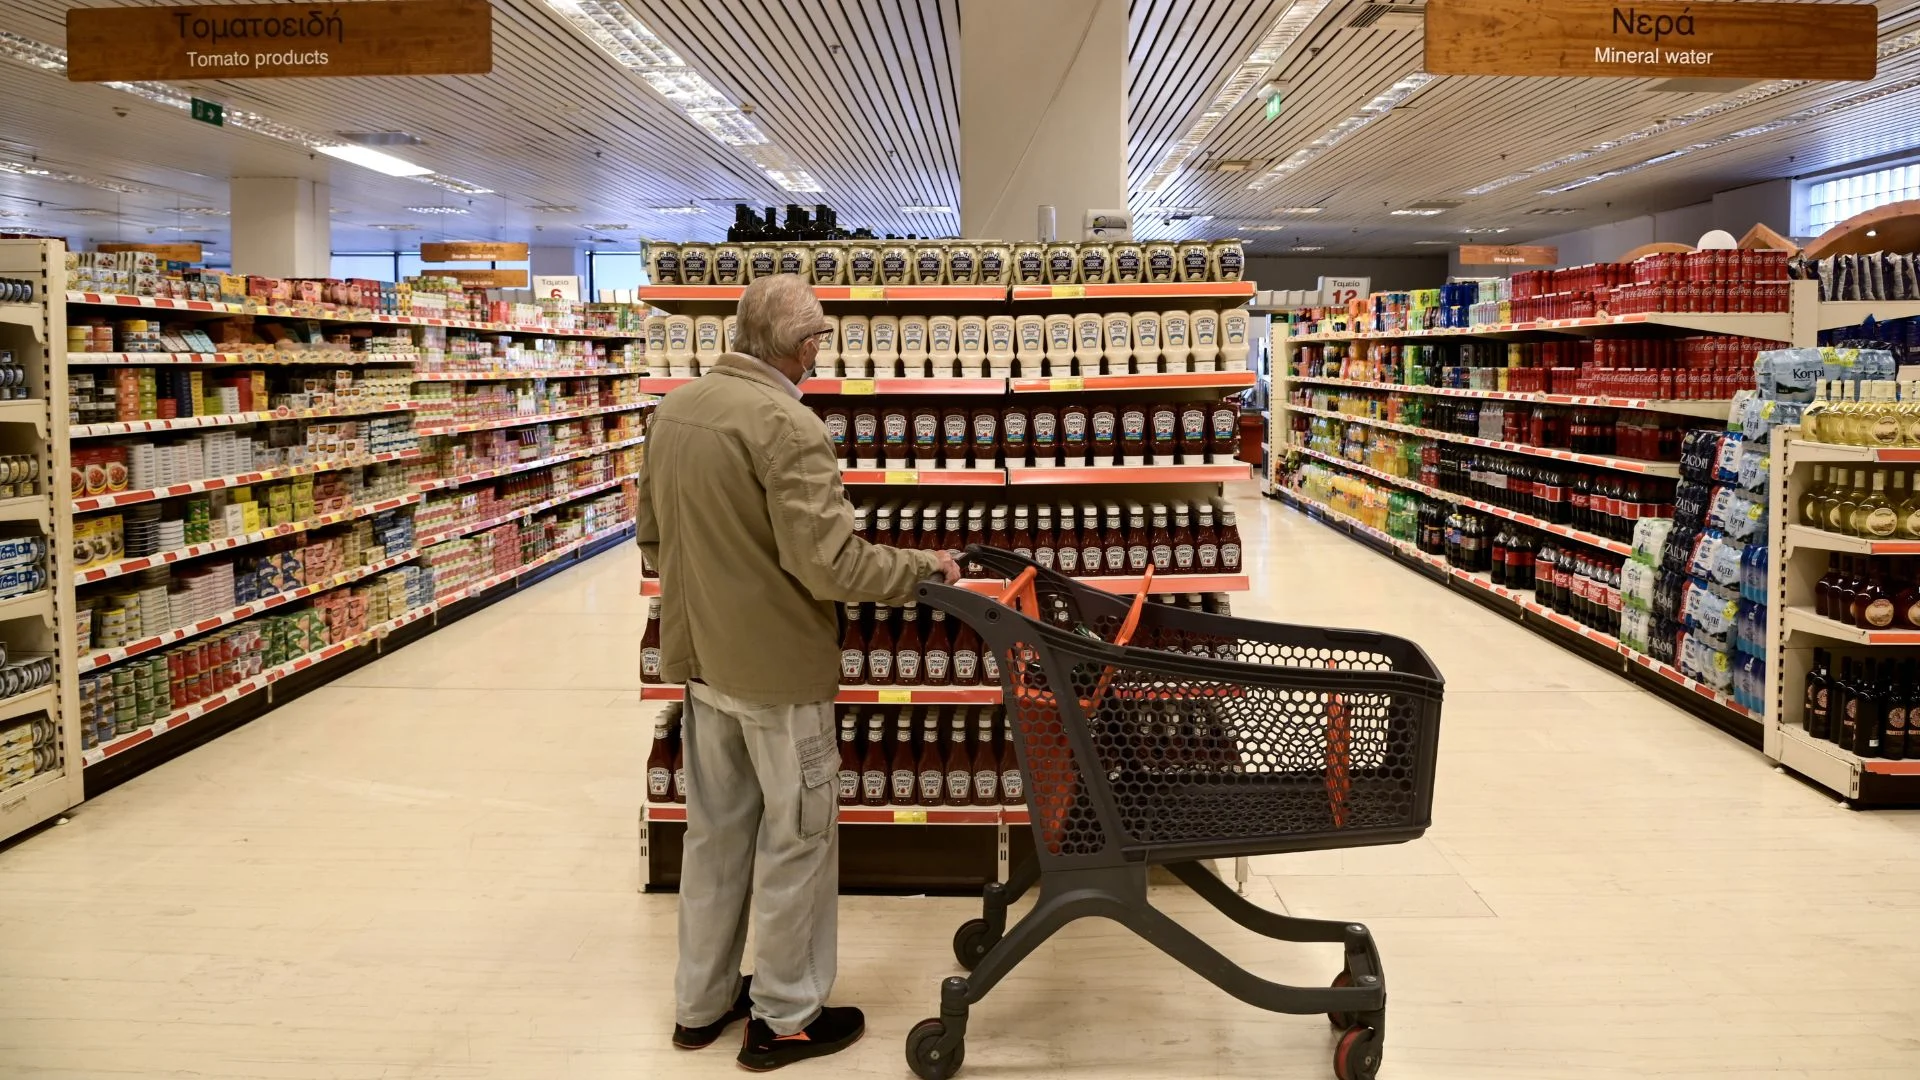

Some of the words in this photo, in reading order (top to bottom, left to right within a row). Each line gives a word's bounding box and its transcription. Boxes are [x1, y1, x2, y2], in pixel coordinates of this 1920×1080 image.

[173, 9, 344, 45] Τοματοειδή
[1613, 7, 1695, 41] Νερά
[187, 51, 250, 67] Tomato
[255, 50, 329, 69] products
[1595, 47, 1659, 64] Mineral
[1665, 49, 1714, 64] water
[1333, 290, 1357, 304] 12
[1793, 367, 1825, 380] Korpi
[1680, 453, 1708, 469] ZAGORI
